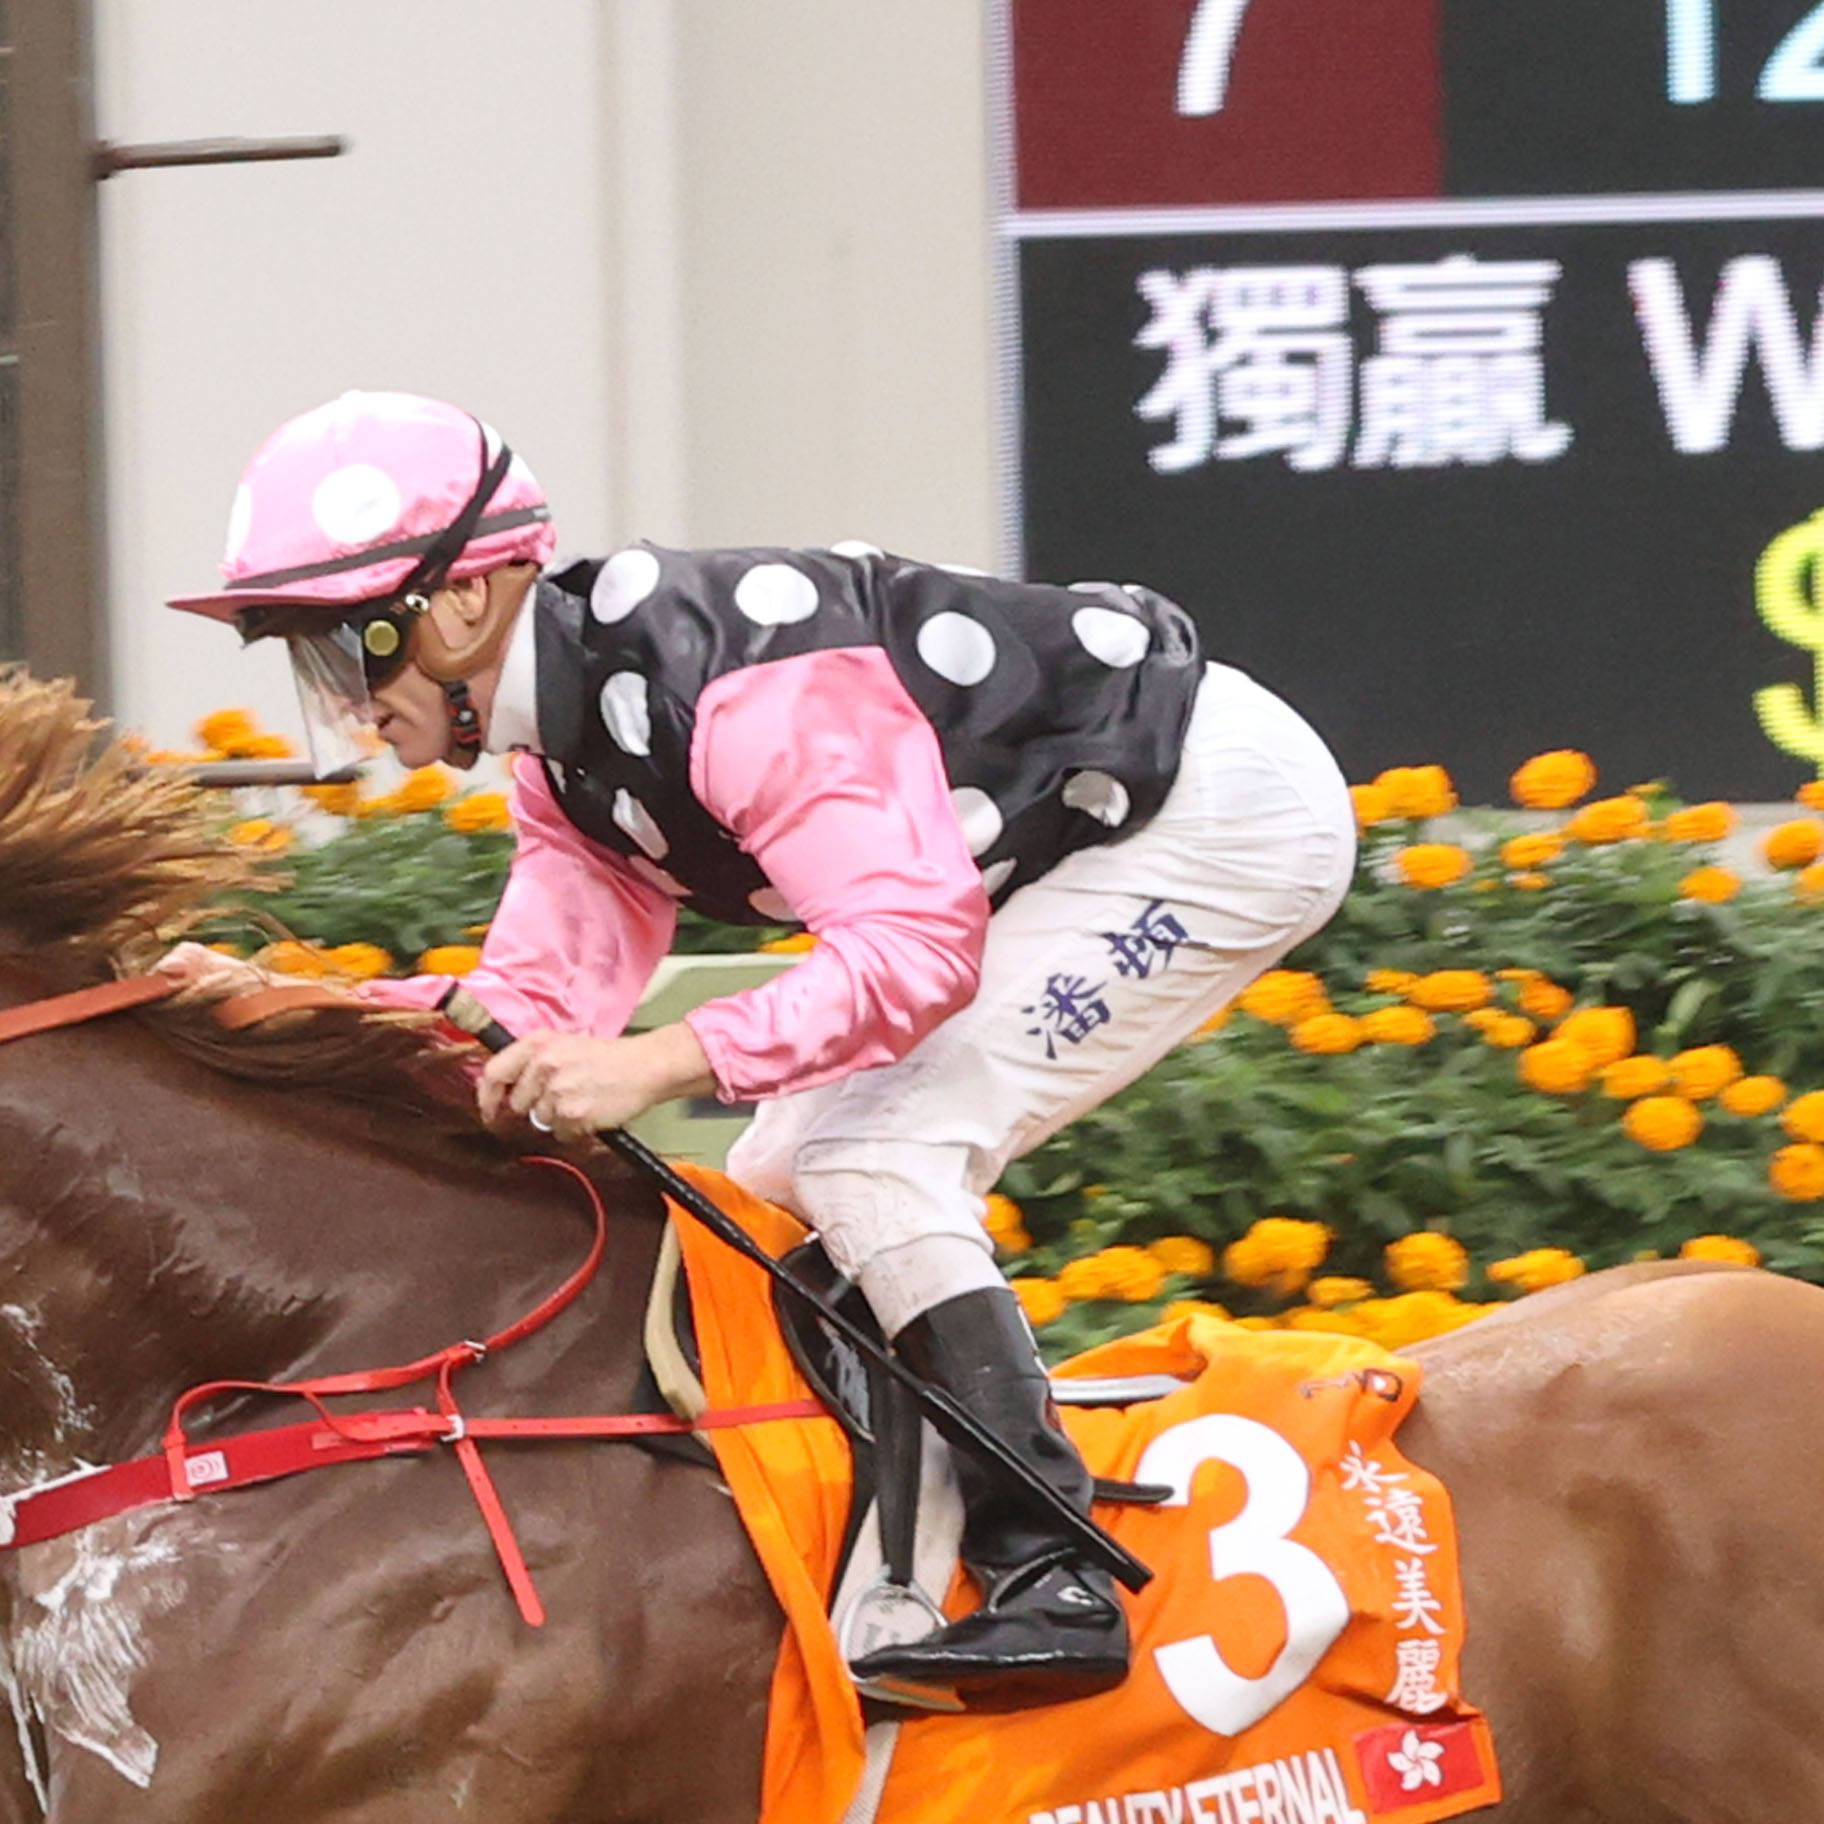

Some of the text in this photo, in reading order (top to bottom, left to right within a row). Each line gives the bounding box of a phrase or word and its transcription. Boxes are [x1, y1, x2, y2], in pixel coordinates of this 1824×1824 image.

[1133, 253, 1578, 472] 獨贏
[1132, 1413, 1352, 1738] 3
[1338, 1439, 1449, 1715] 永遠美麗
